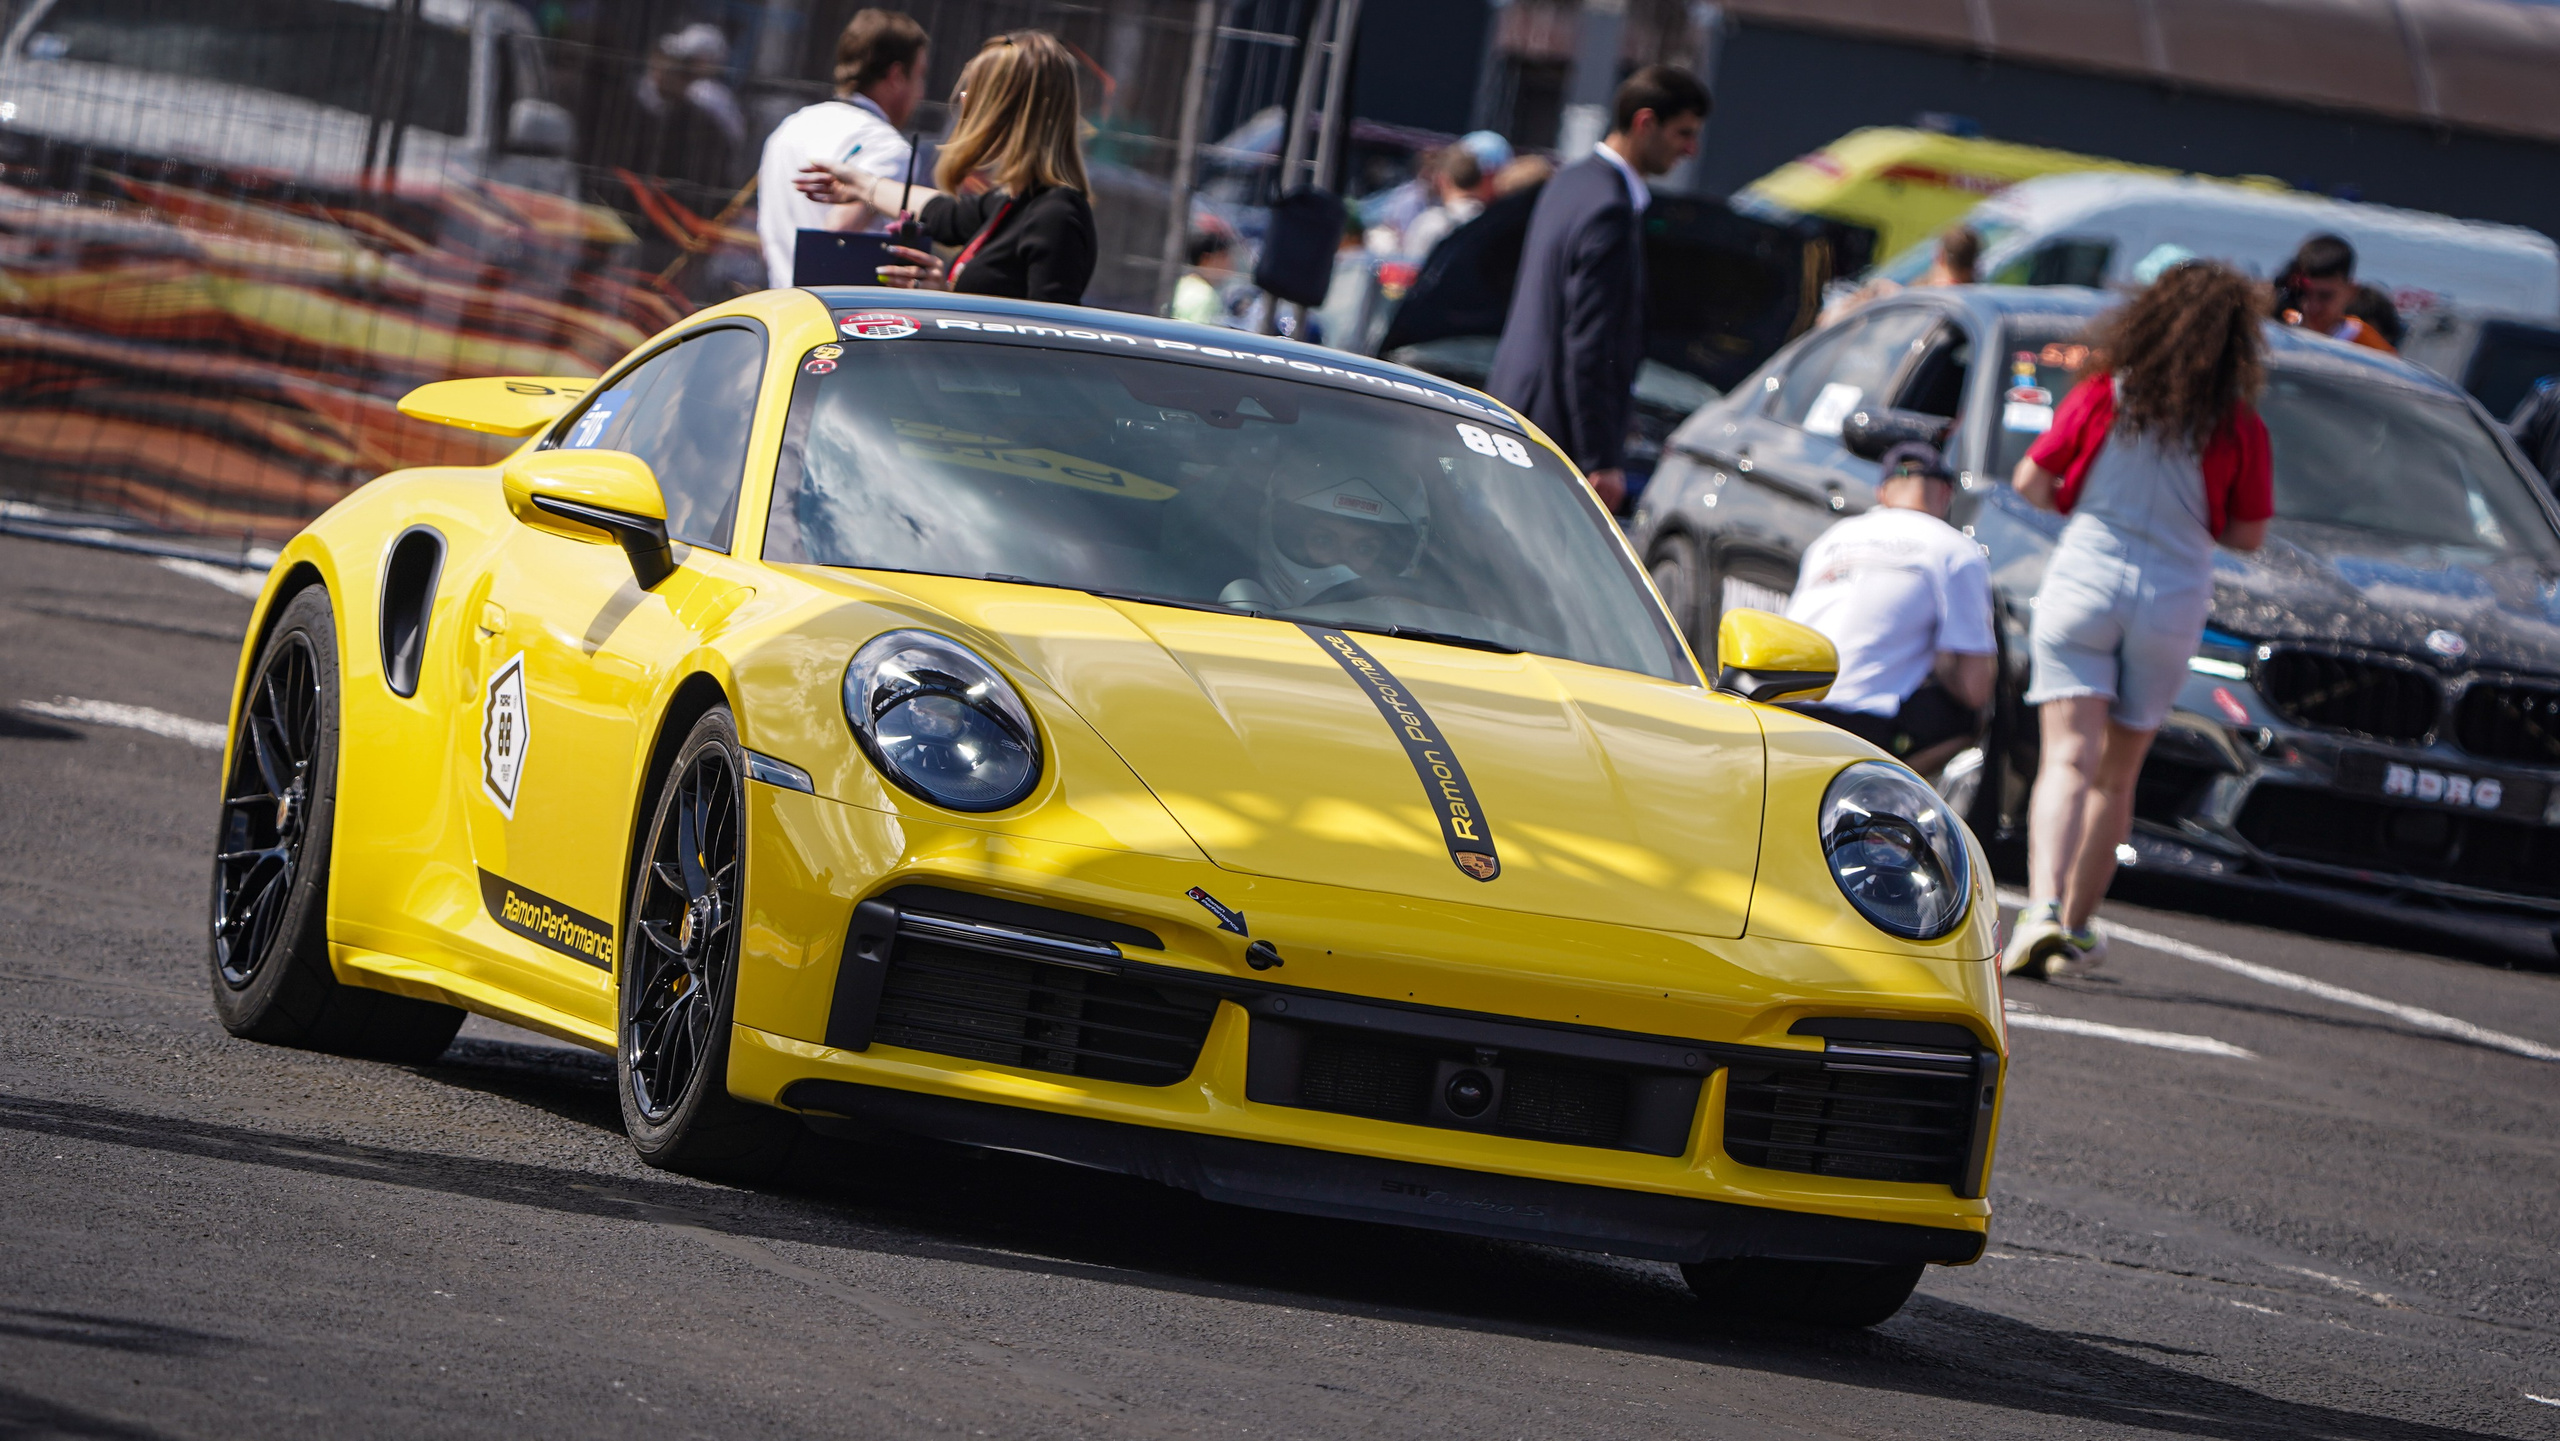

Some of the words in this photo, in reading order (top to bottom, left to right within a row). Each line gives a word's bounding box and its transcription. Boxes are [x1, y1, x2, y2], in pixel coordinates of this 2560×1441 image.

[936, 318, 1137, 345] Ramon
[1154, 338, 1517, 424] Performance
[1456, 422, 1534, 468] 88
[1338, 496, 1379, 512] SIMPSON
[1324, 634, 1433, 743] Performance
[1424, 750, 1479, 841] Ramon
